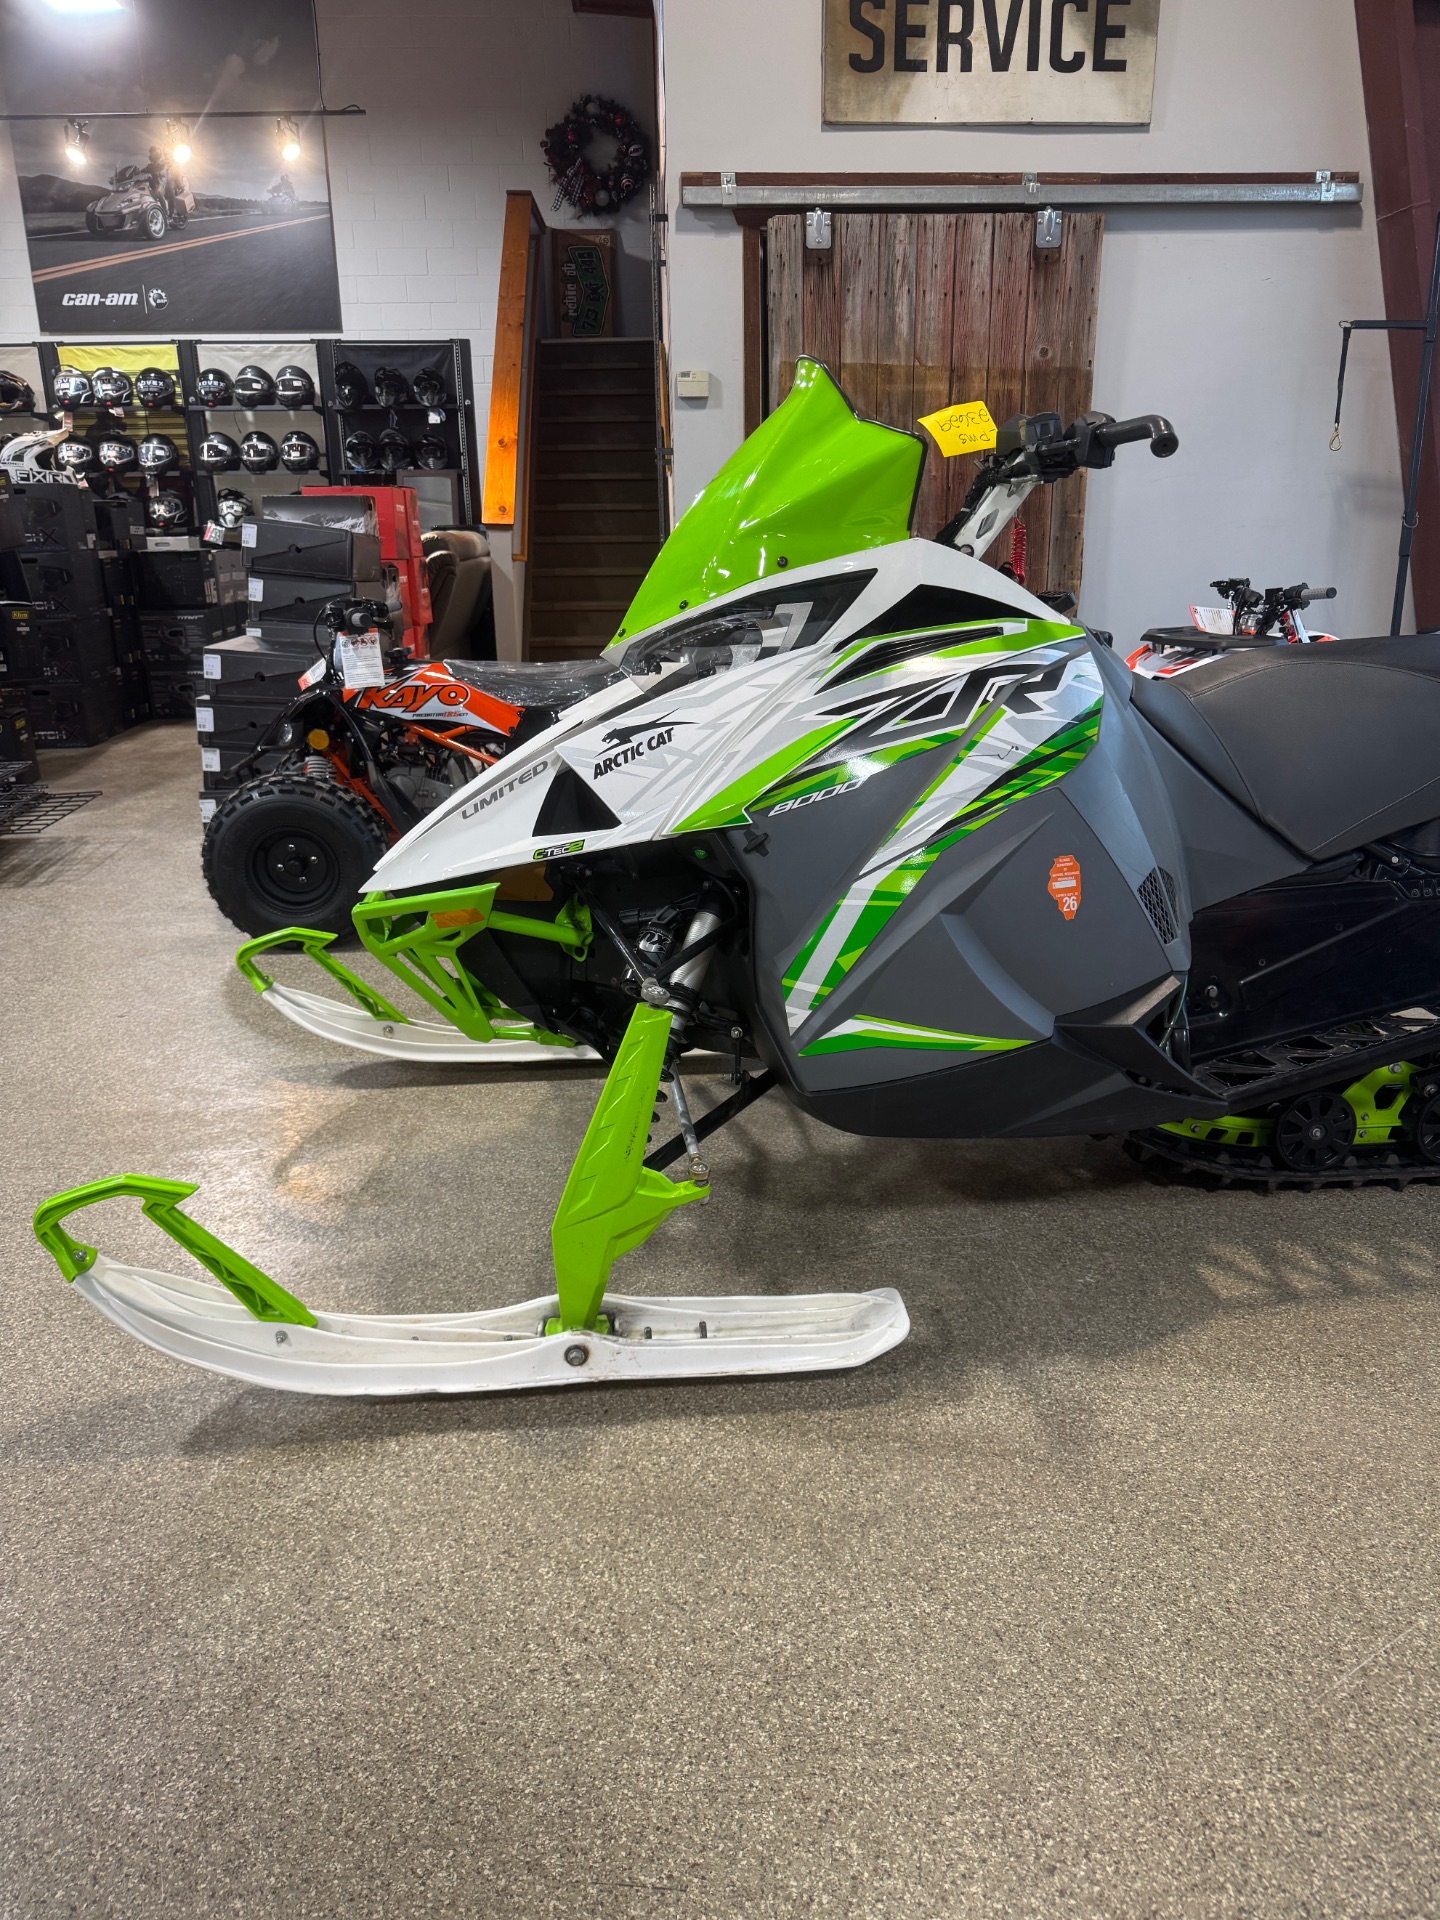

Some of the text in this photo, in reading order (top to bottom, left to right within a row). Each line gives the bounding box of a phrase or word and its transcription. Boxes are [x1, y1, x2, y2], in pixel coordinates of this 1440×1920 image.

[849, 0, 1127, 73] SERVICE
[62, 293, 138, 306] can-am
[935, 408, 990, 432] 23629
[357, 678, 469, 713] KAYO
[594, 726, 675, 780] ARCTIC CAT
[461, 760, 549, 820] LIMITED
[768, 776, 869, 817] 8000
[1062, 896, 1077, 911] 26
